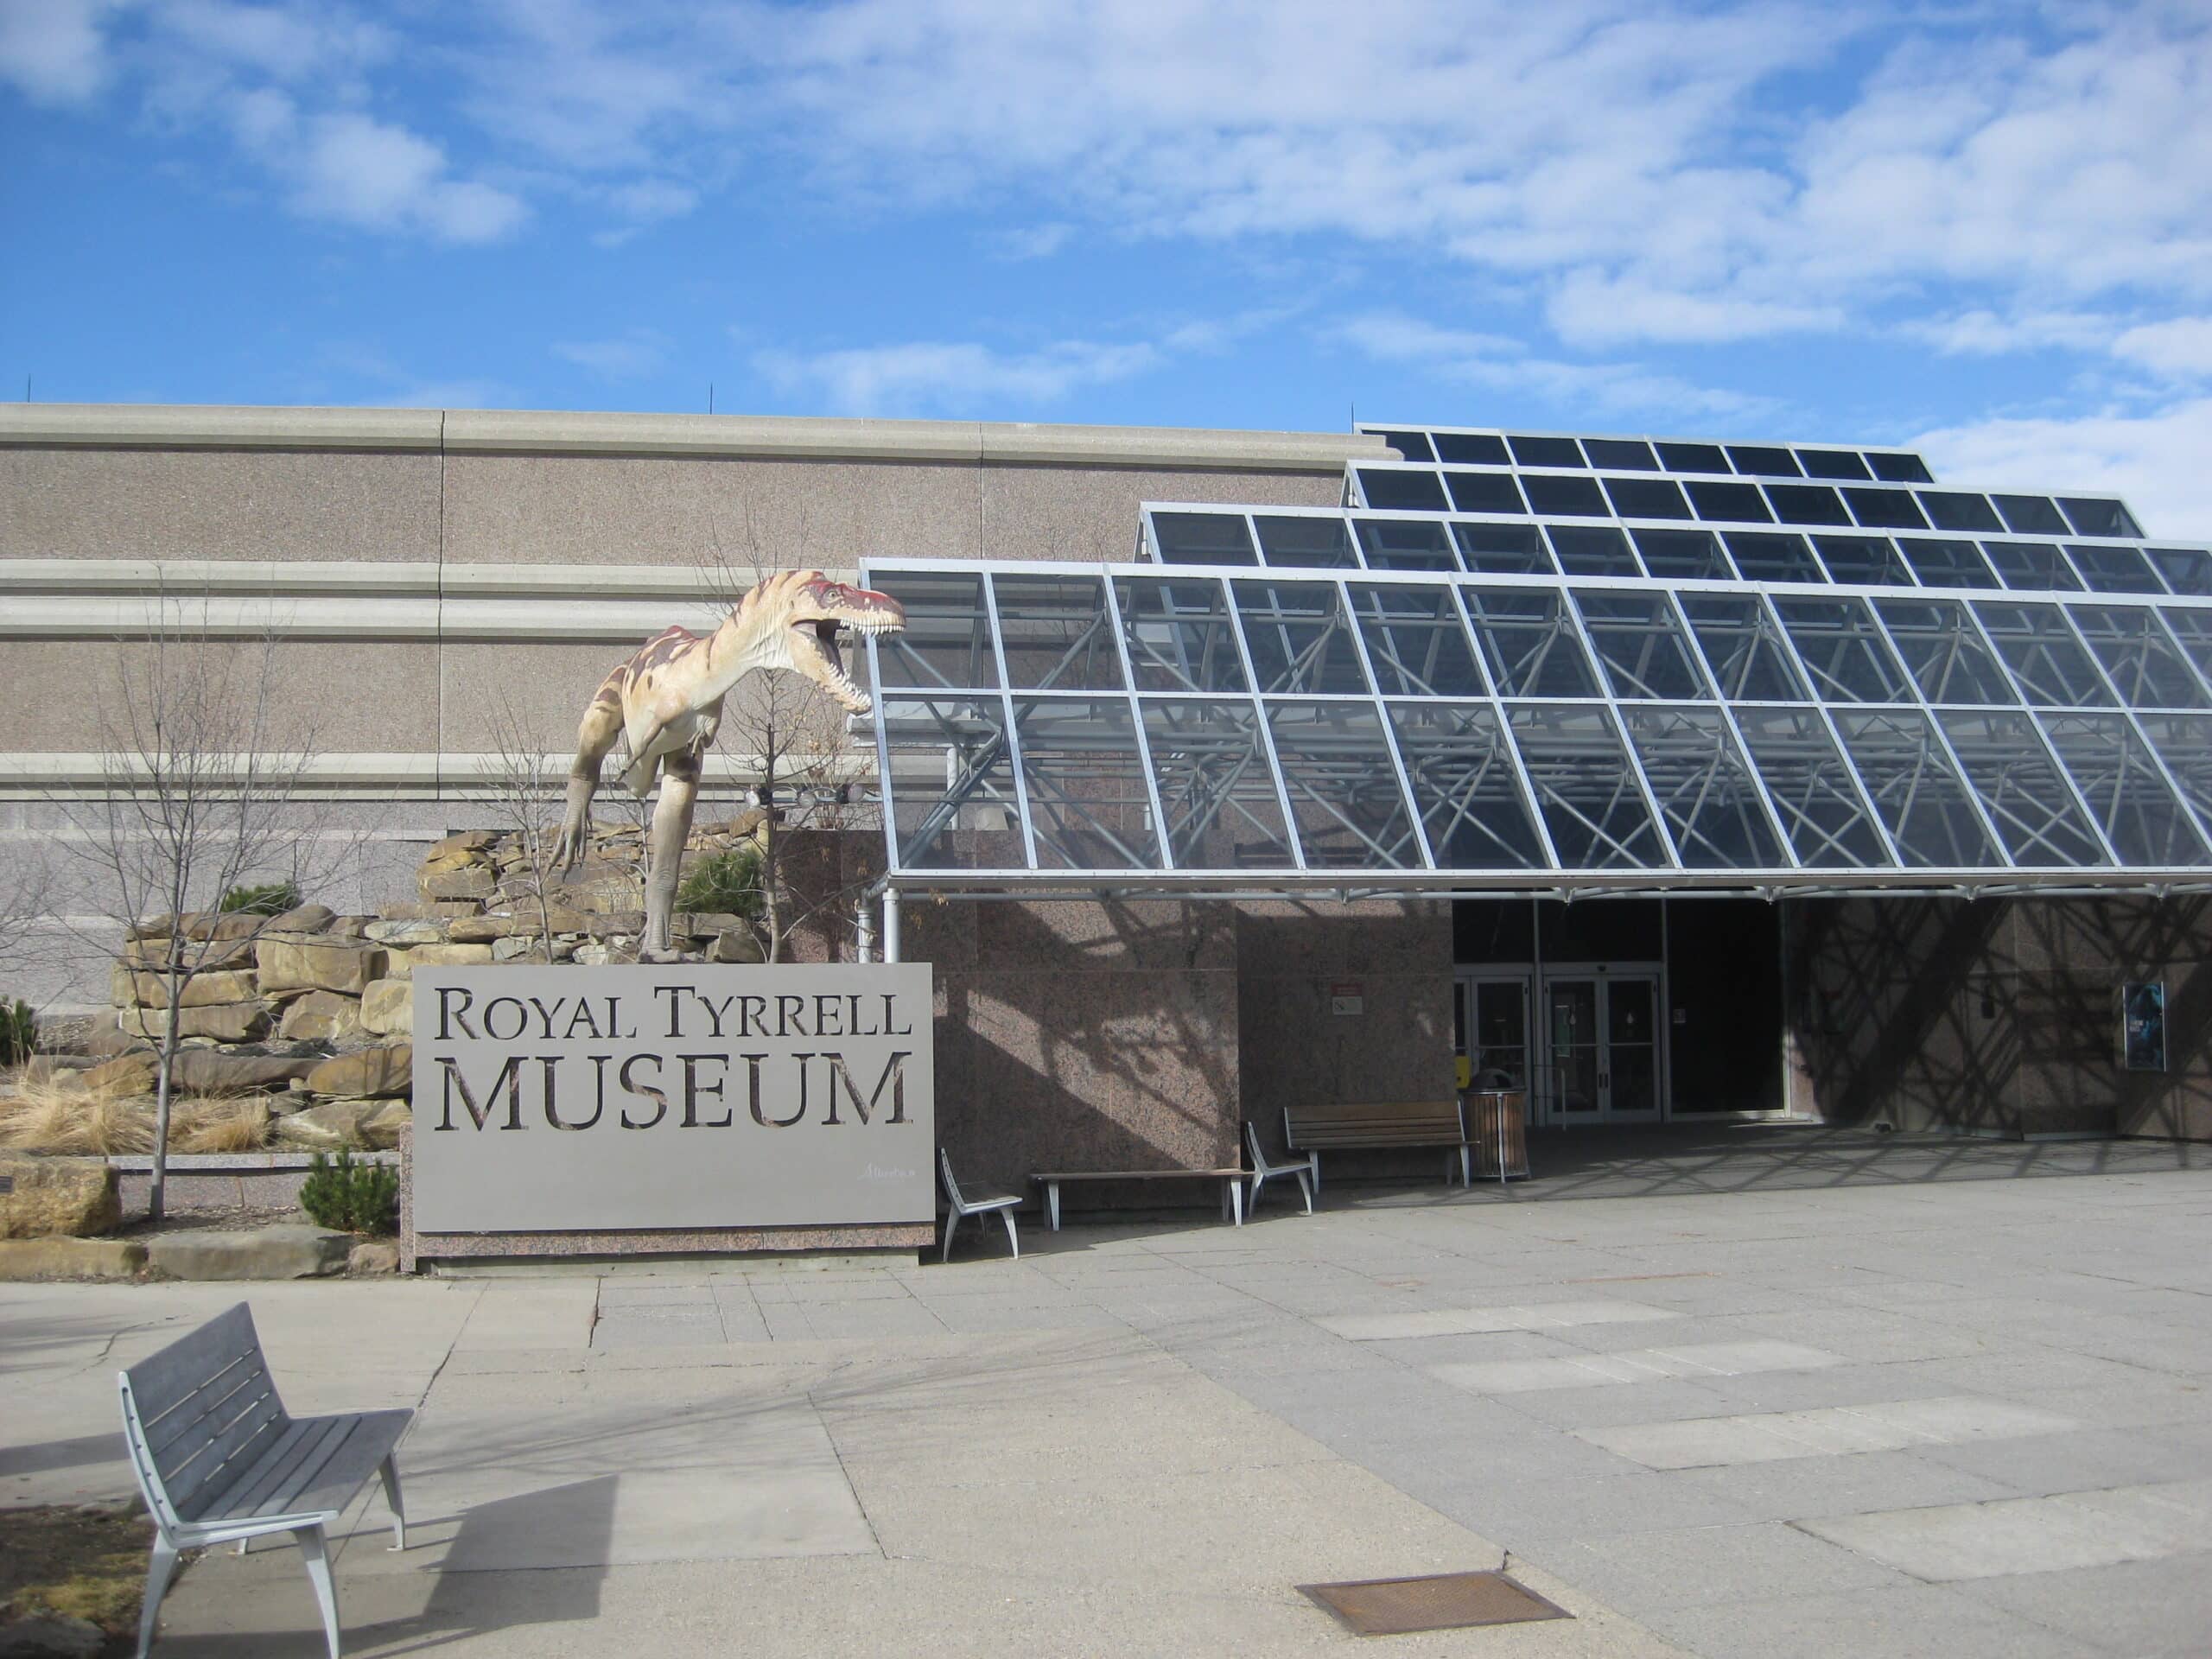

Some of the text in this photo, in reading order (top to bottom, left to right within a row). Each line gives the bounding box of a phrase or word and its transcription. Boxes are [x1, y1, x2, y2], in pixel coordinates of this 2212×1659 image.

[434, 985, 912, 1041] ROYAL TYRRELL
[434, 1051, 914, 1132] MUSEUM
